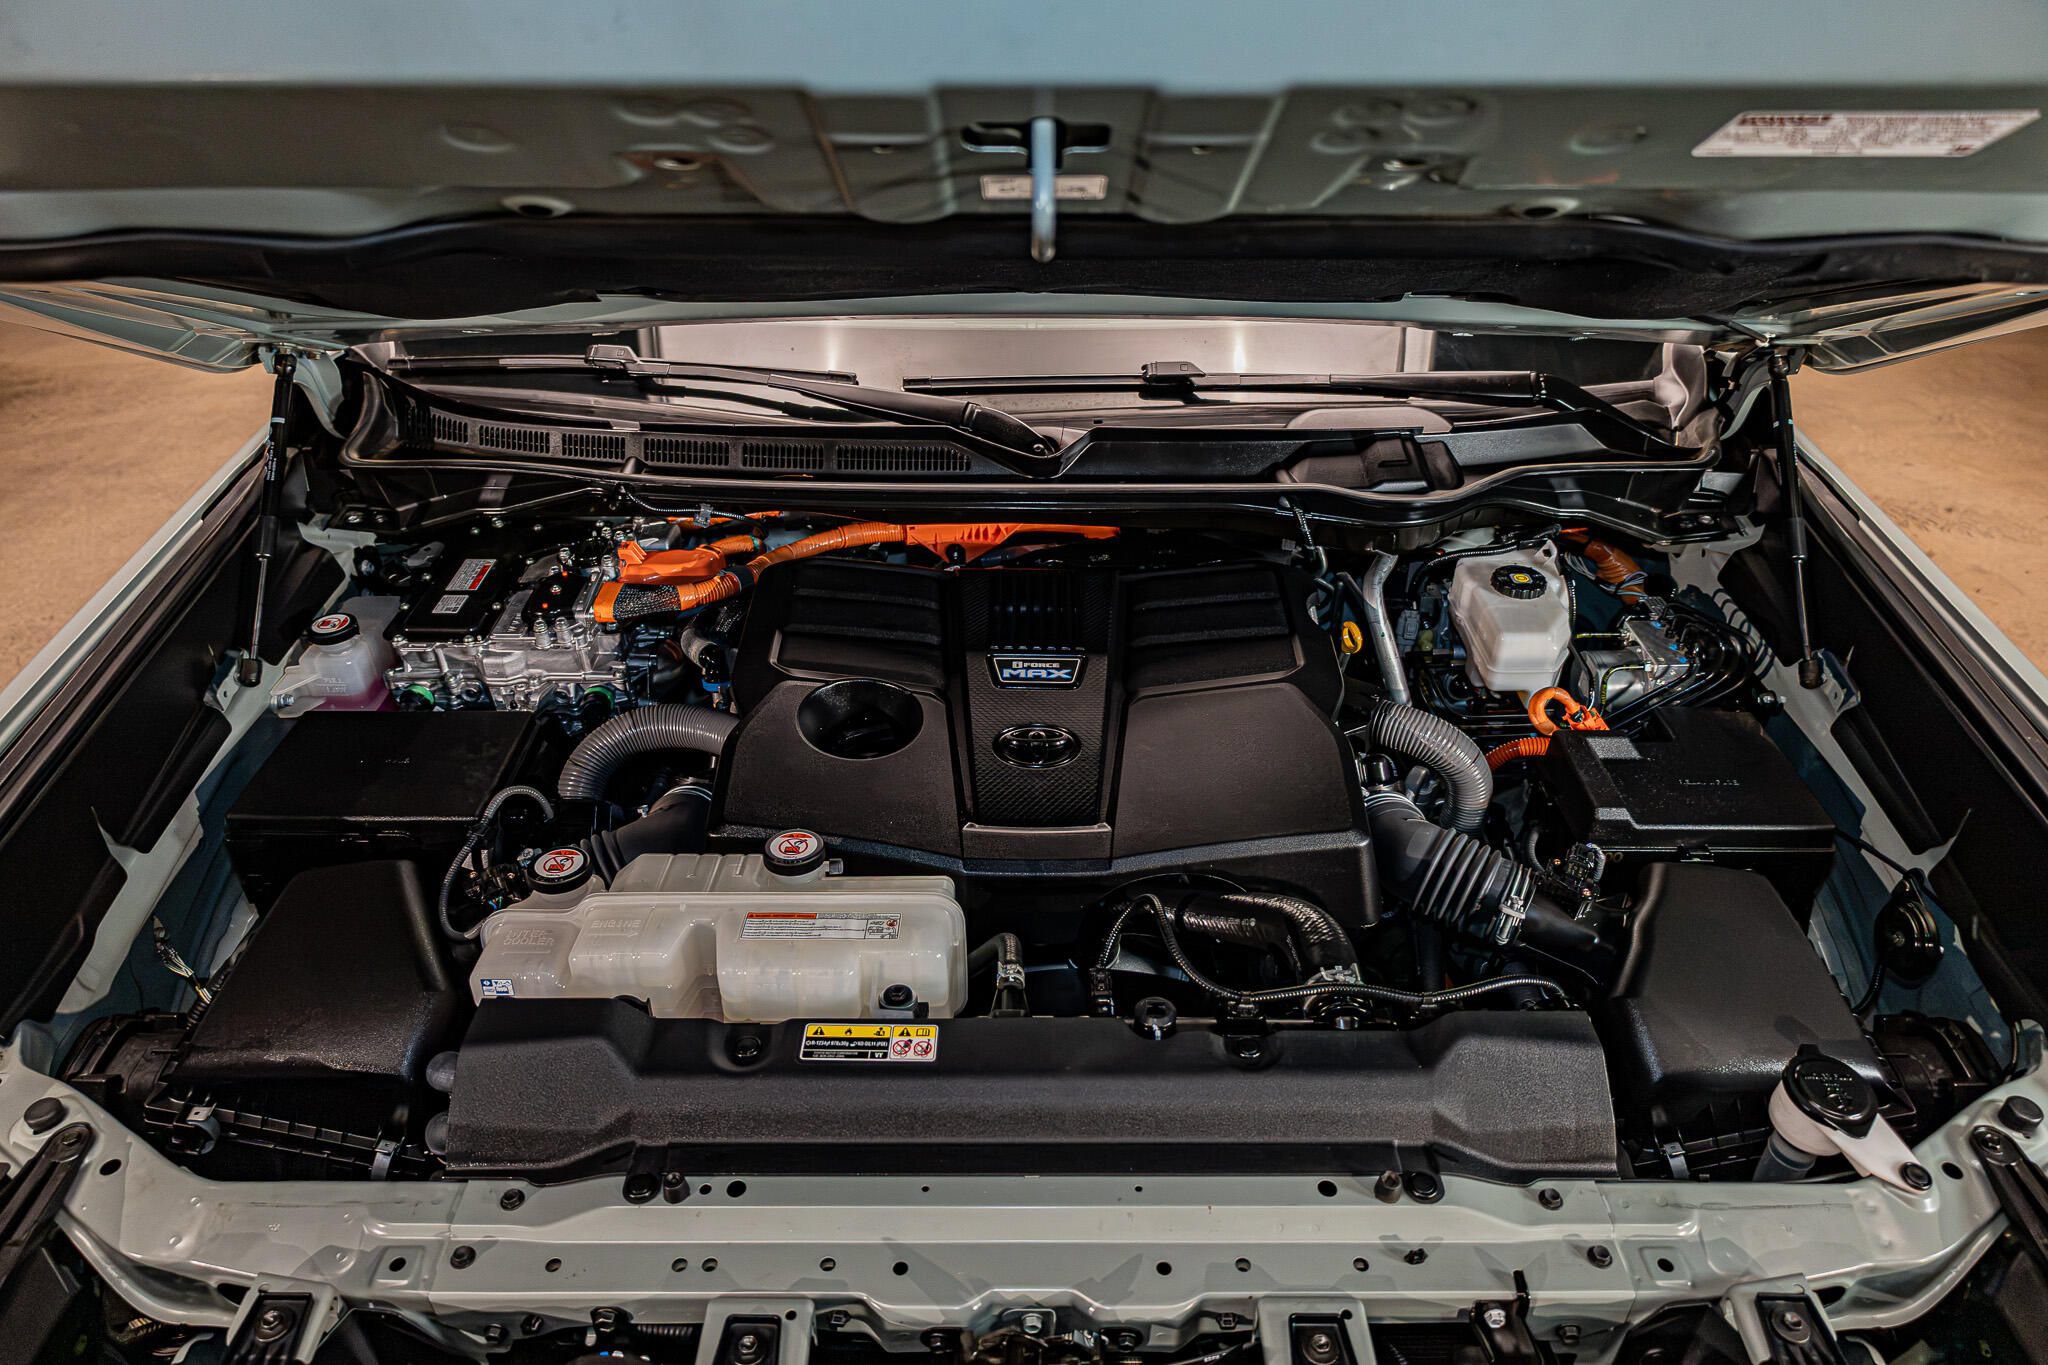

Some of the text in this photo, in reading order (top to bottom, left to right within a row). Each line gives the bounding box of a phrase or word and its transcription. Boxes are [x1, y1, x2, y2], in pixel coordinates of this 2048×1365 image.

[1002, 668, 1072, 679] MAX
[591, 919, 642, 928] ENGINE
[504, 937, 554, 946] COOLER
